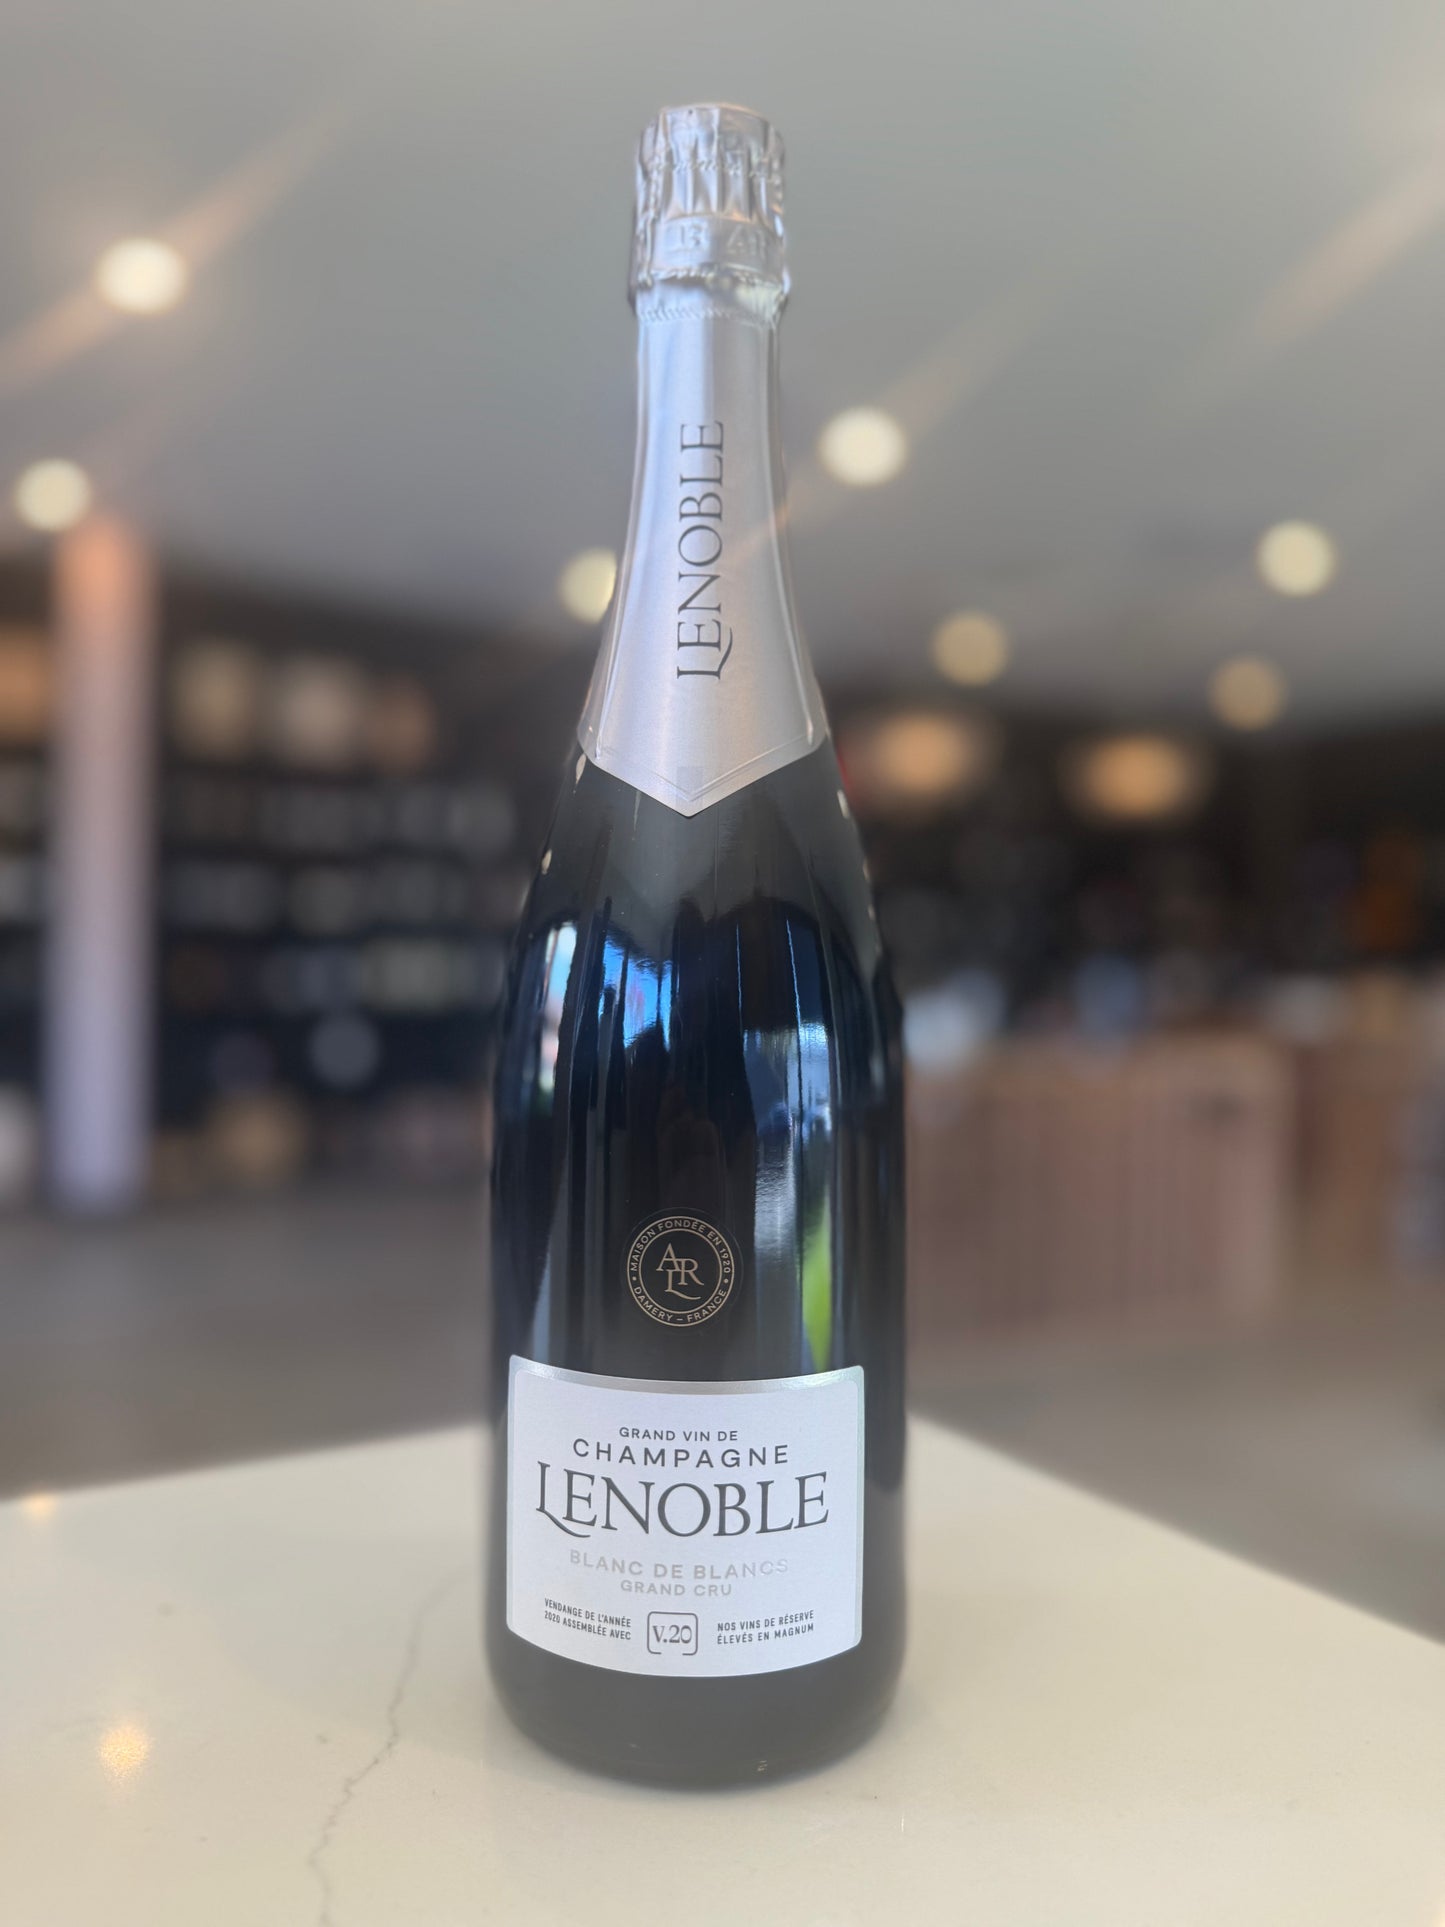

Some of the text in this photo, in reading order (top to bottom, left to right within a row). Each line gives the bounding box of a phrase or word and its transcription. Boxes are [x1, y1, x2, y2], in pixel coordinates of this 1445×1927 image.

[676, 420, 733, 680] LENOBLE
[630, 1219, 731, 1273] MAISON FONDÉE EN 1920
[634, 1286, 673, 1322] DAMERY
[687, 1289, 726, 1322] FRANCE
[619, 1426, 738, 1441] GRAND VIN DE
[573, 1438, 789, 1468] CHAMPAGNE
[535, 1461, 829, 1538] LENOBLE
[569, 1549, 789, 1580] BLANC DE BLANCS
[620, 1580, 732, 1597] GRAND CRU
[544, 1597, 583, 1618] VENDANGE
[585, 1609, 595, 1621] DE
[717, 1609, 814, 1632] NOS VINS DE RÉSERVE
[544, 1611, 631, 1640] 2020 ASSEMBLÉE AVEC
[652, 1624, 692, 1644] V.20
[717, 1623, 814, 1645] ÉLEVÉS EN MAGNUM
